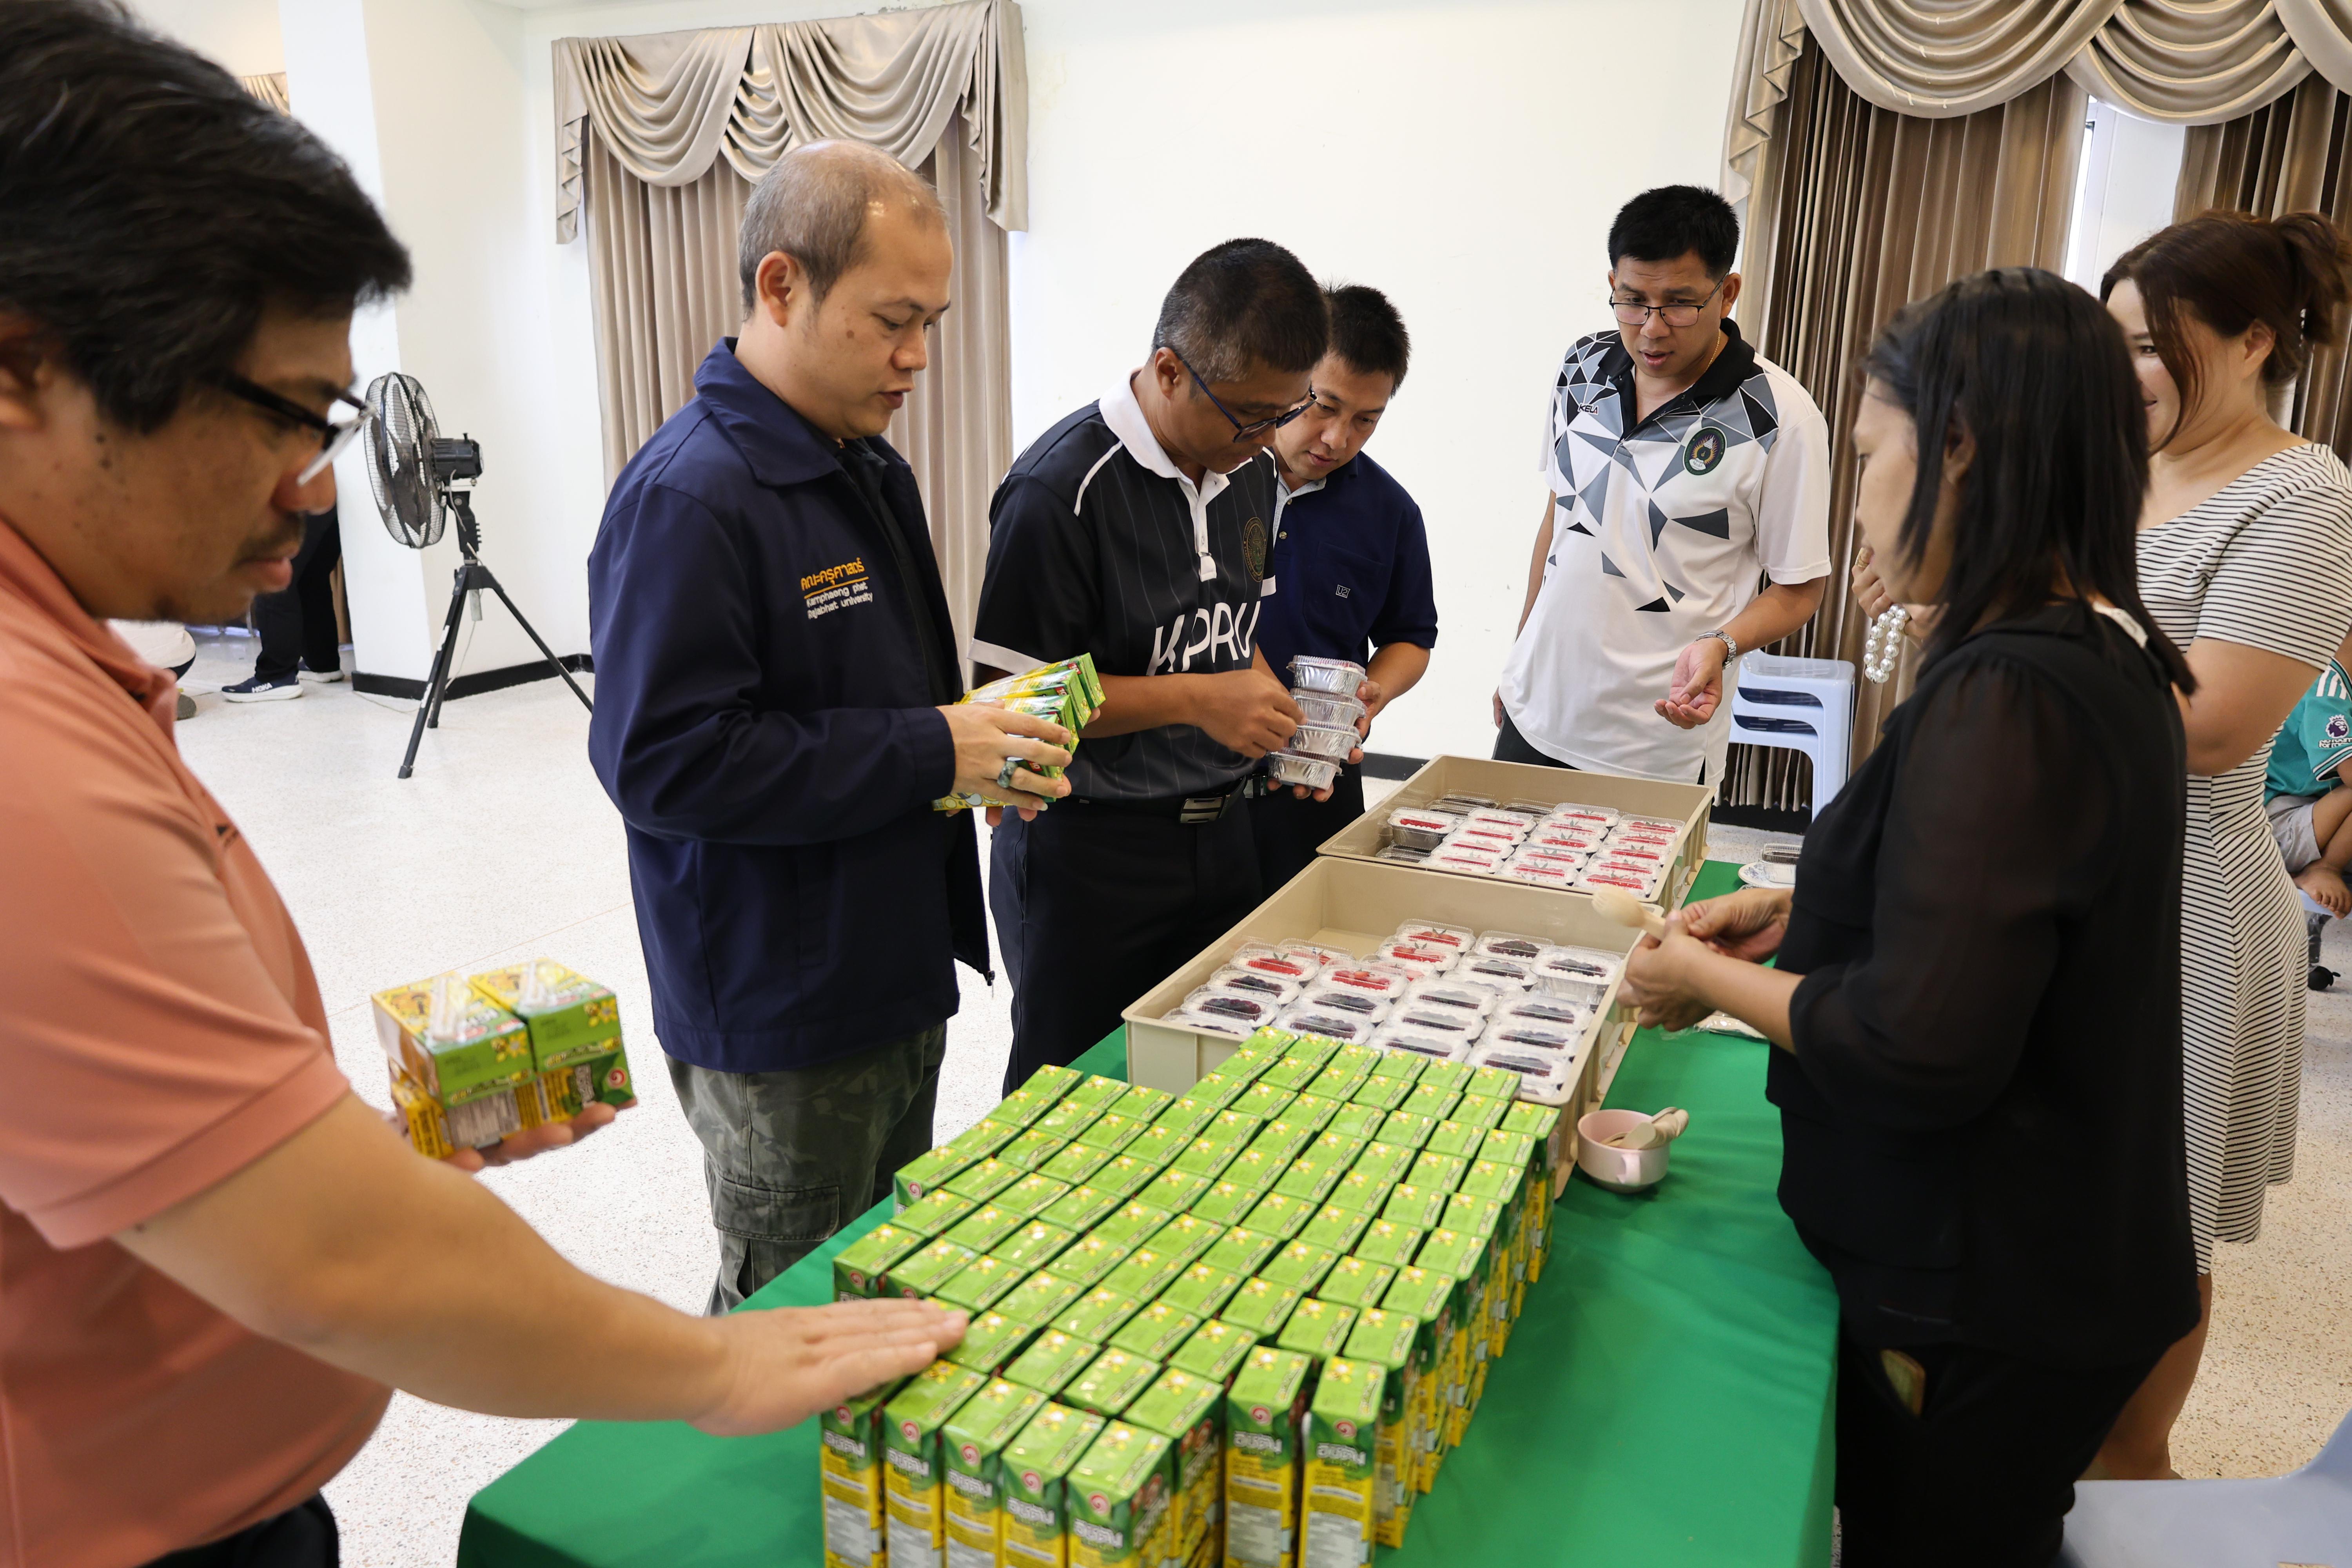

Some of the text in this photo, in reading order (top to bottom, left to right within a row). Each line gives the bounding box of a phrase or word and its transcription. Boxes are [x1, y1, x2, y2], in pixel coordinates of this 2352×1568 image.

[1578, 403, 1598, 414] KELA
[800, 557, 865, 591] คณะครุศาสตร์
[1338, 587, 1348, 596] U2
[1146, 601, 1261, 676] KPRU
[252, 682, 272, 693] HOKA
